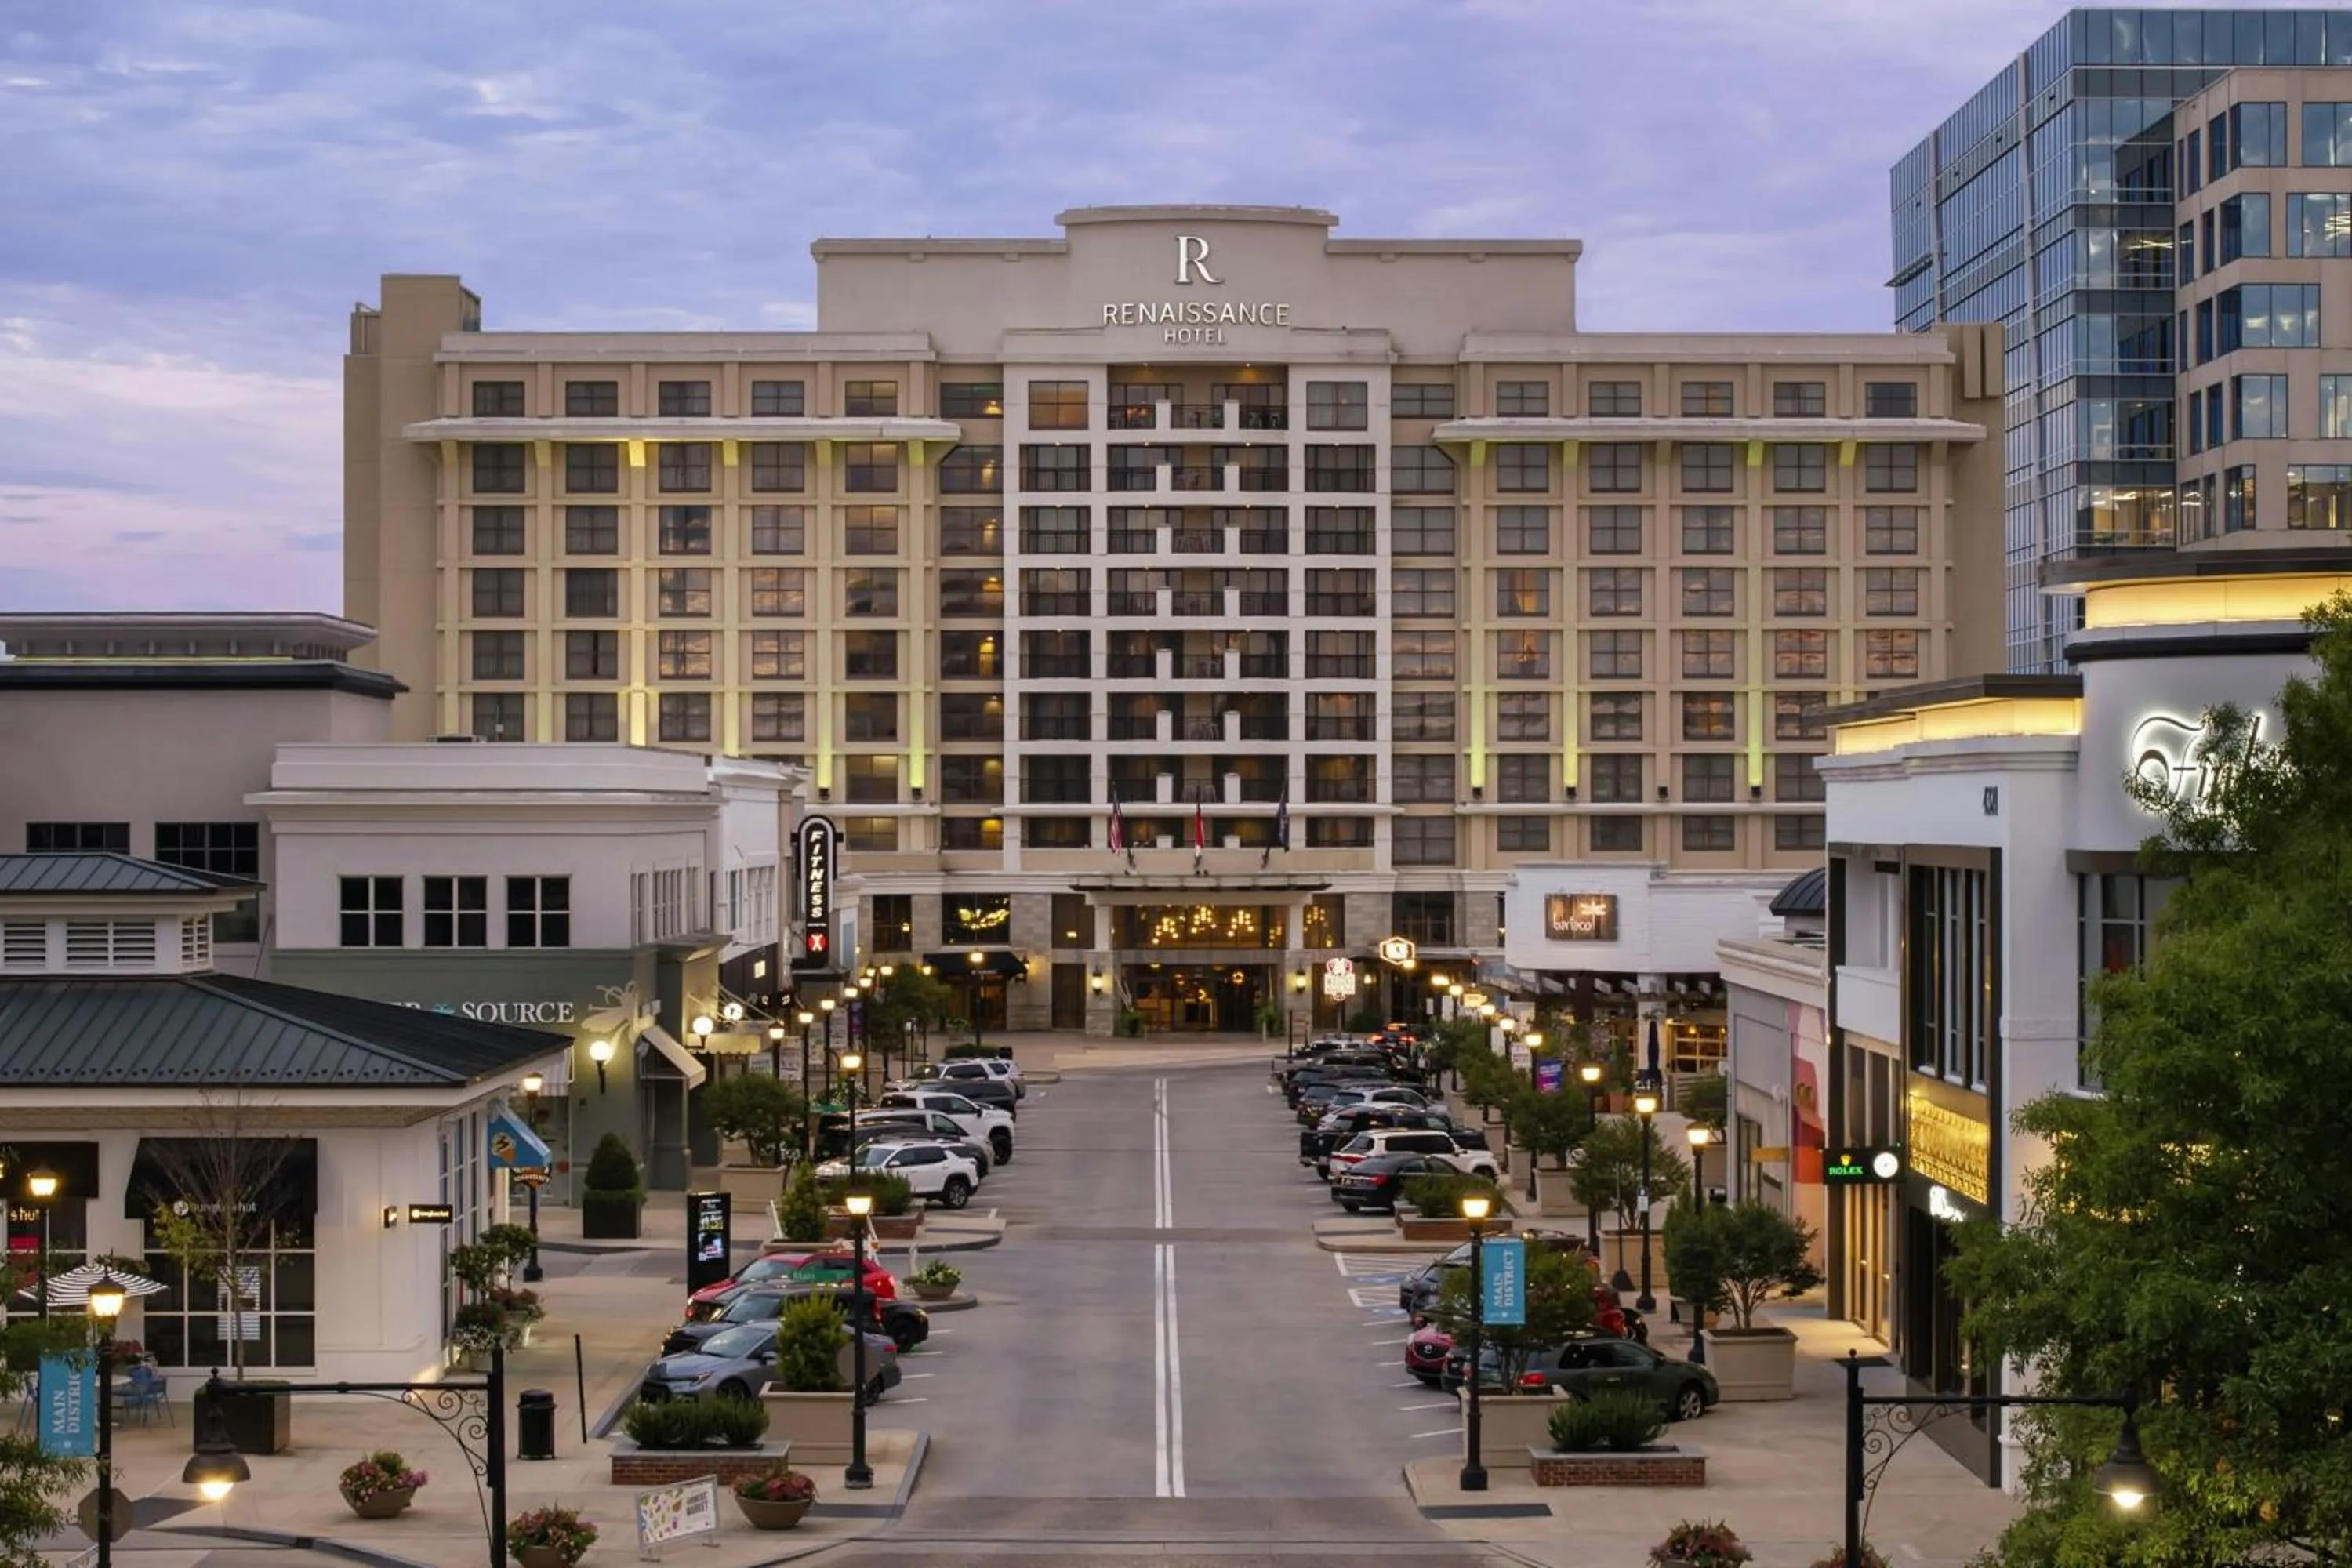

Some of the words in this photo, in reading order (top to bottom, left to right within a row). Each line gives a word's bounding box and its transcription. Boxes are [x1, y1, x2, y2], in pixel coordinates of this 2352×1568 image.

[1174, 236, 1223, 283] R
[1102, 302, 1290, 325] RENAISSANCE
[1164, 329, 1225, 343] HOTEL
[810, 830, 824, 918] FITNESS
[462, 1002, 575, 1023] SOURCE
[1828, 1166, 1863, 1175] ROLEX
[1494, 1272, 1503, 1308] MAIN
[1504, 1249, 1514, 1307] DISTRICT
[53, 1391, 66, 1434] MAIN
[67, 1364, 81, 1434] DISTRIC
